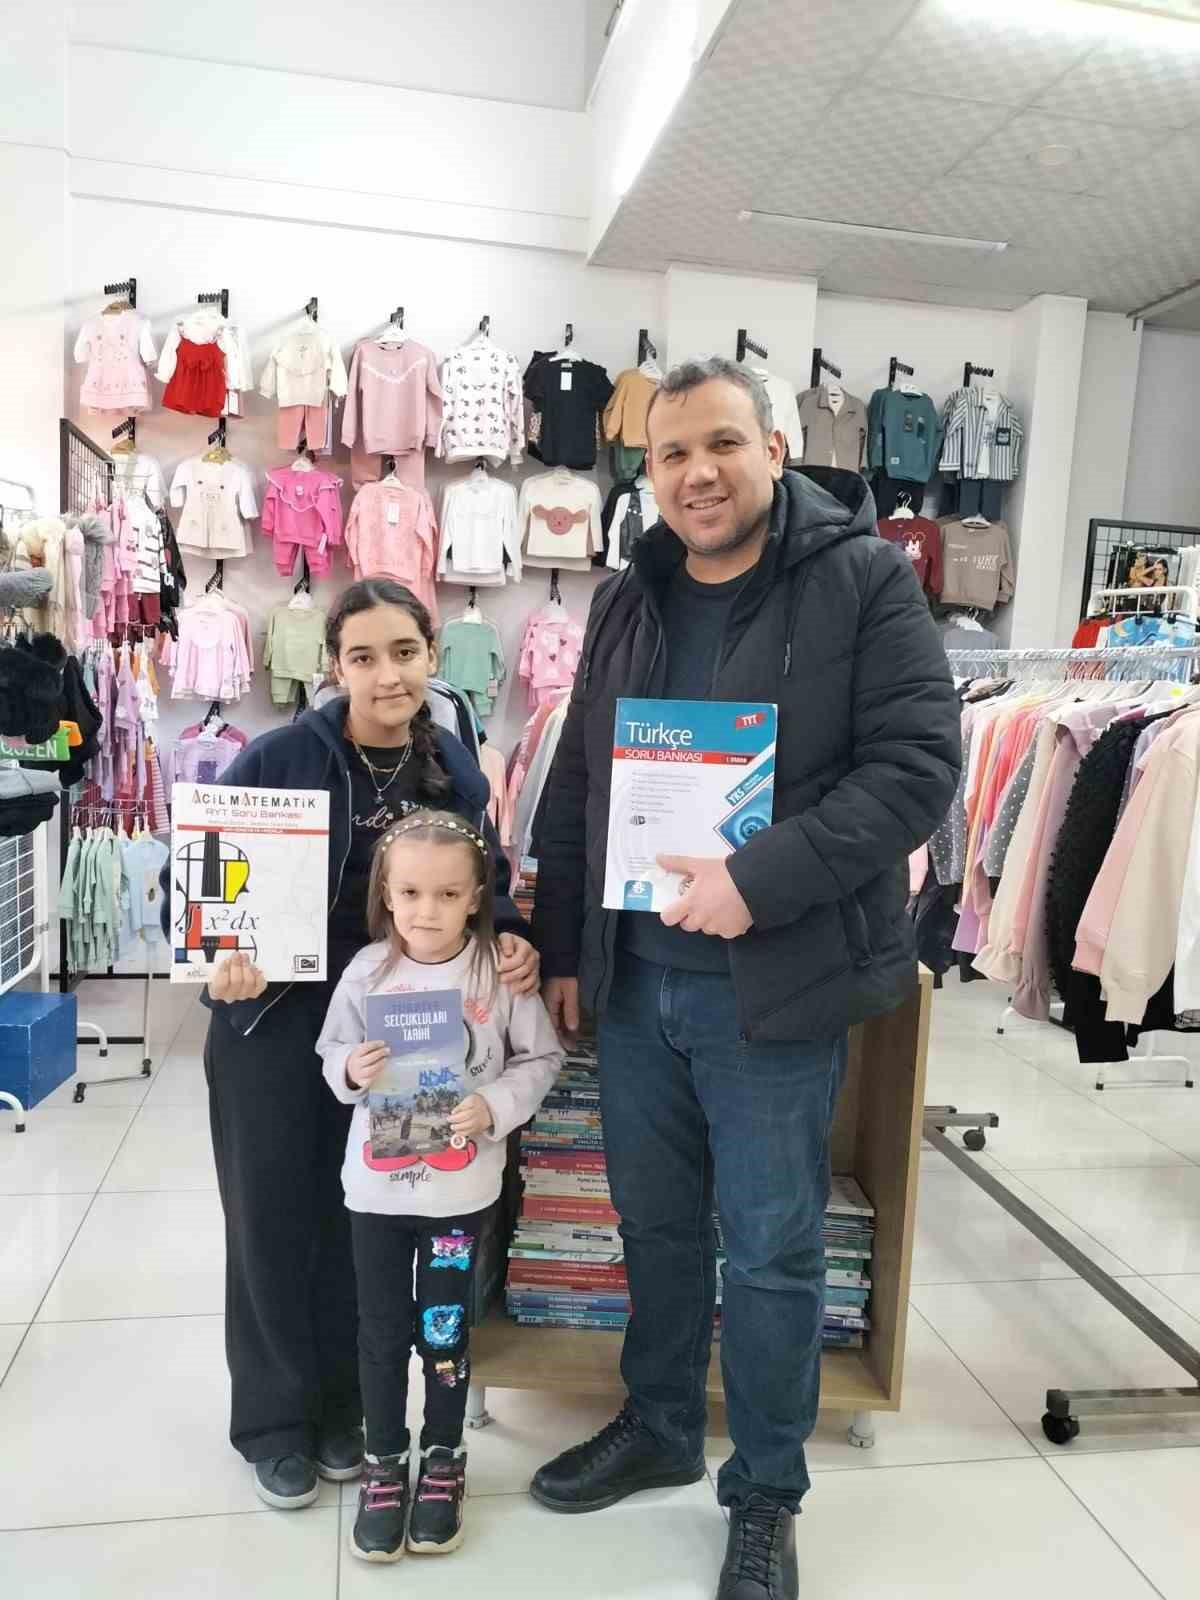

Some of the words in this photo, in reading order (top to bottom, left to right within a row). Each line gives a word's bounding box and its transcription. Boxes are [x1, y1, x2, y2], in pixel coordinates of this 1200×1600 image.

[625, 721, 693, 750] Türkçe
[624, 749, 655, 760] SORU
[656, 751, 704, 763] BANKASI
[389, 1166, 432, 1189] simple
